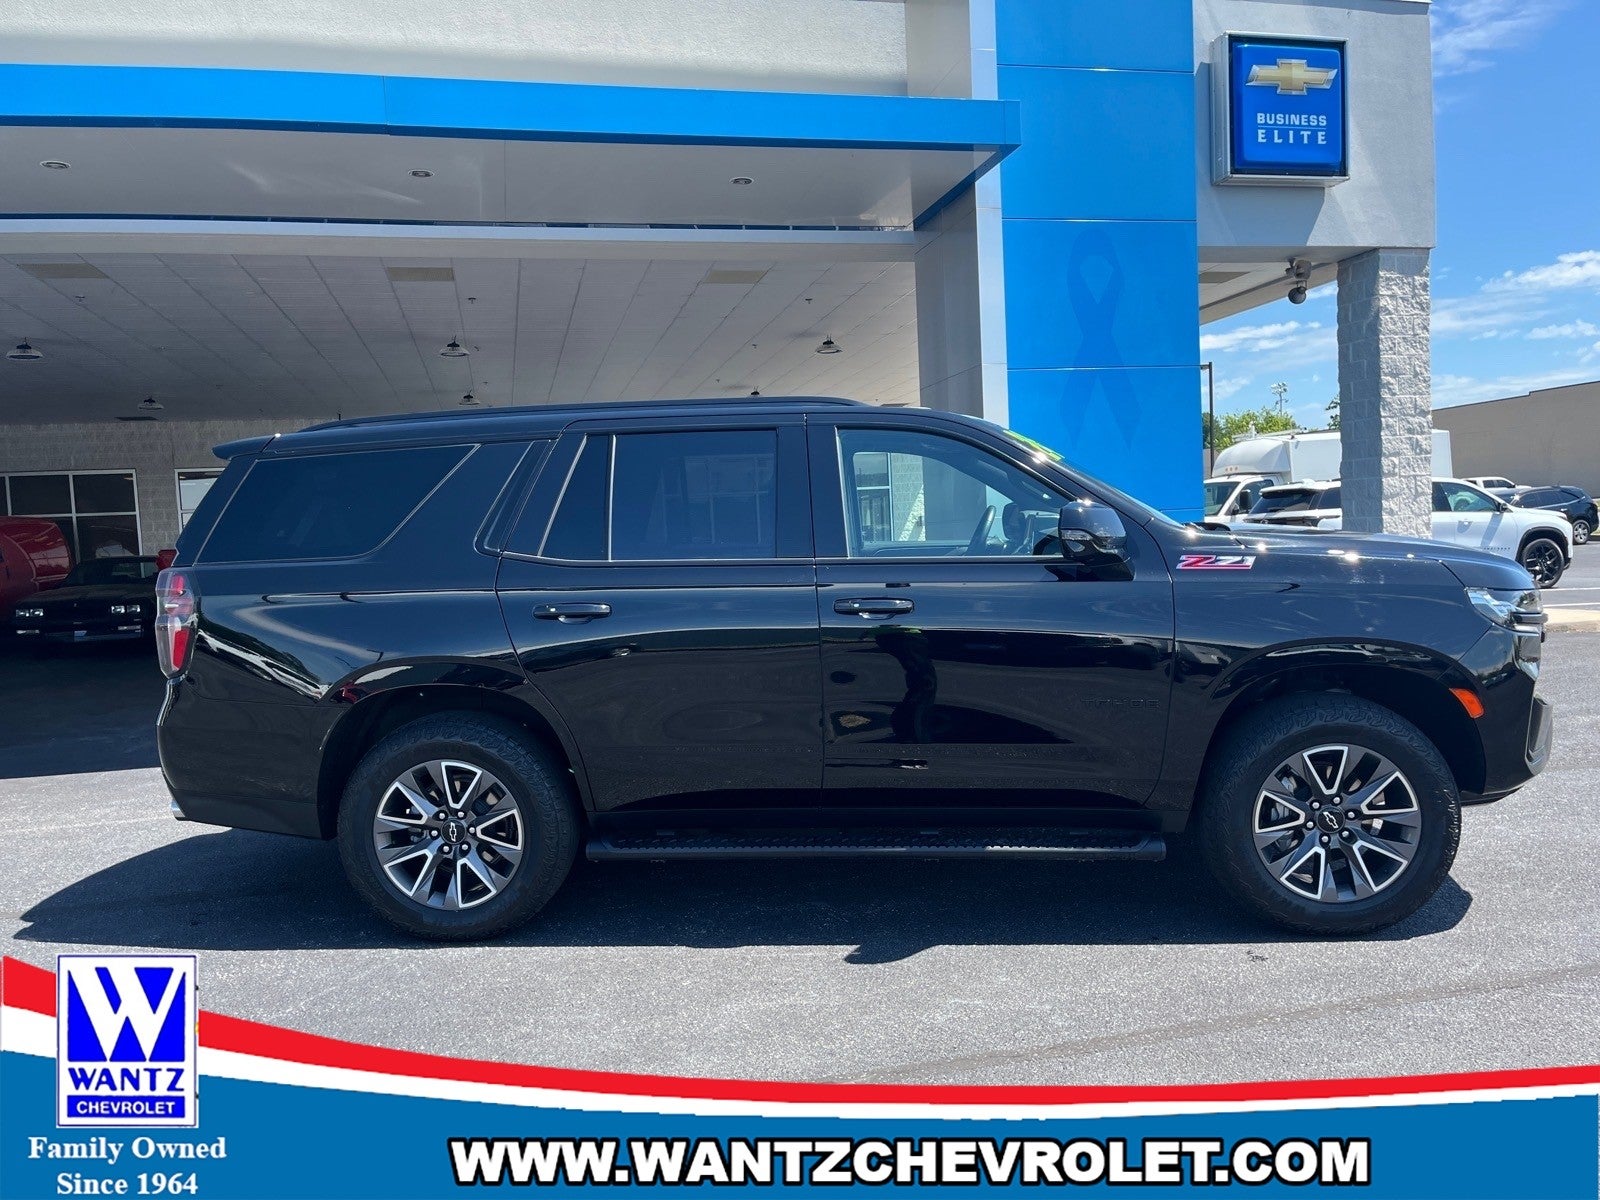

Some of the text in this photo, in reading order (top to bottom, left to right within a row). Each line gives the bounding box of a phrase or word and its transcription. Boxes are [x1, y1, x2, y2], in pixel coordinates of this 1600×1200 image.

[1257, 113, 1327, 126] BUSINESS
[1257, 129, 1327, 145] ELITE
[1176, 555, 1256, 569] Z71
